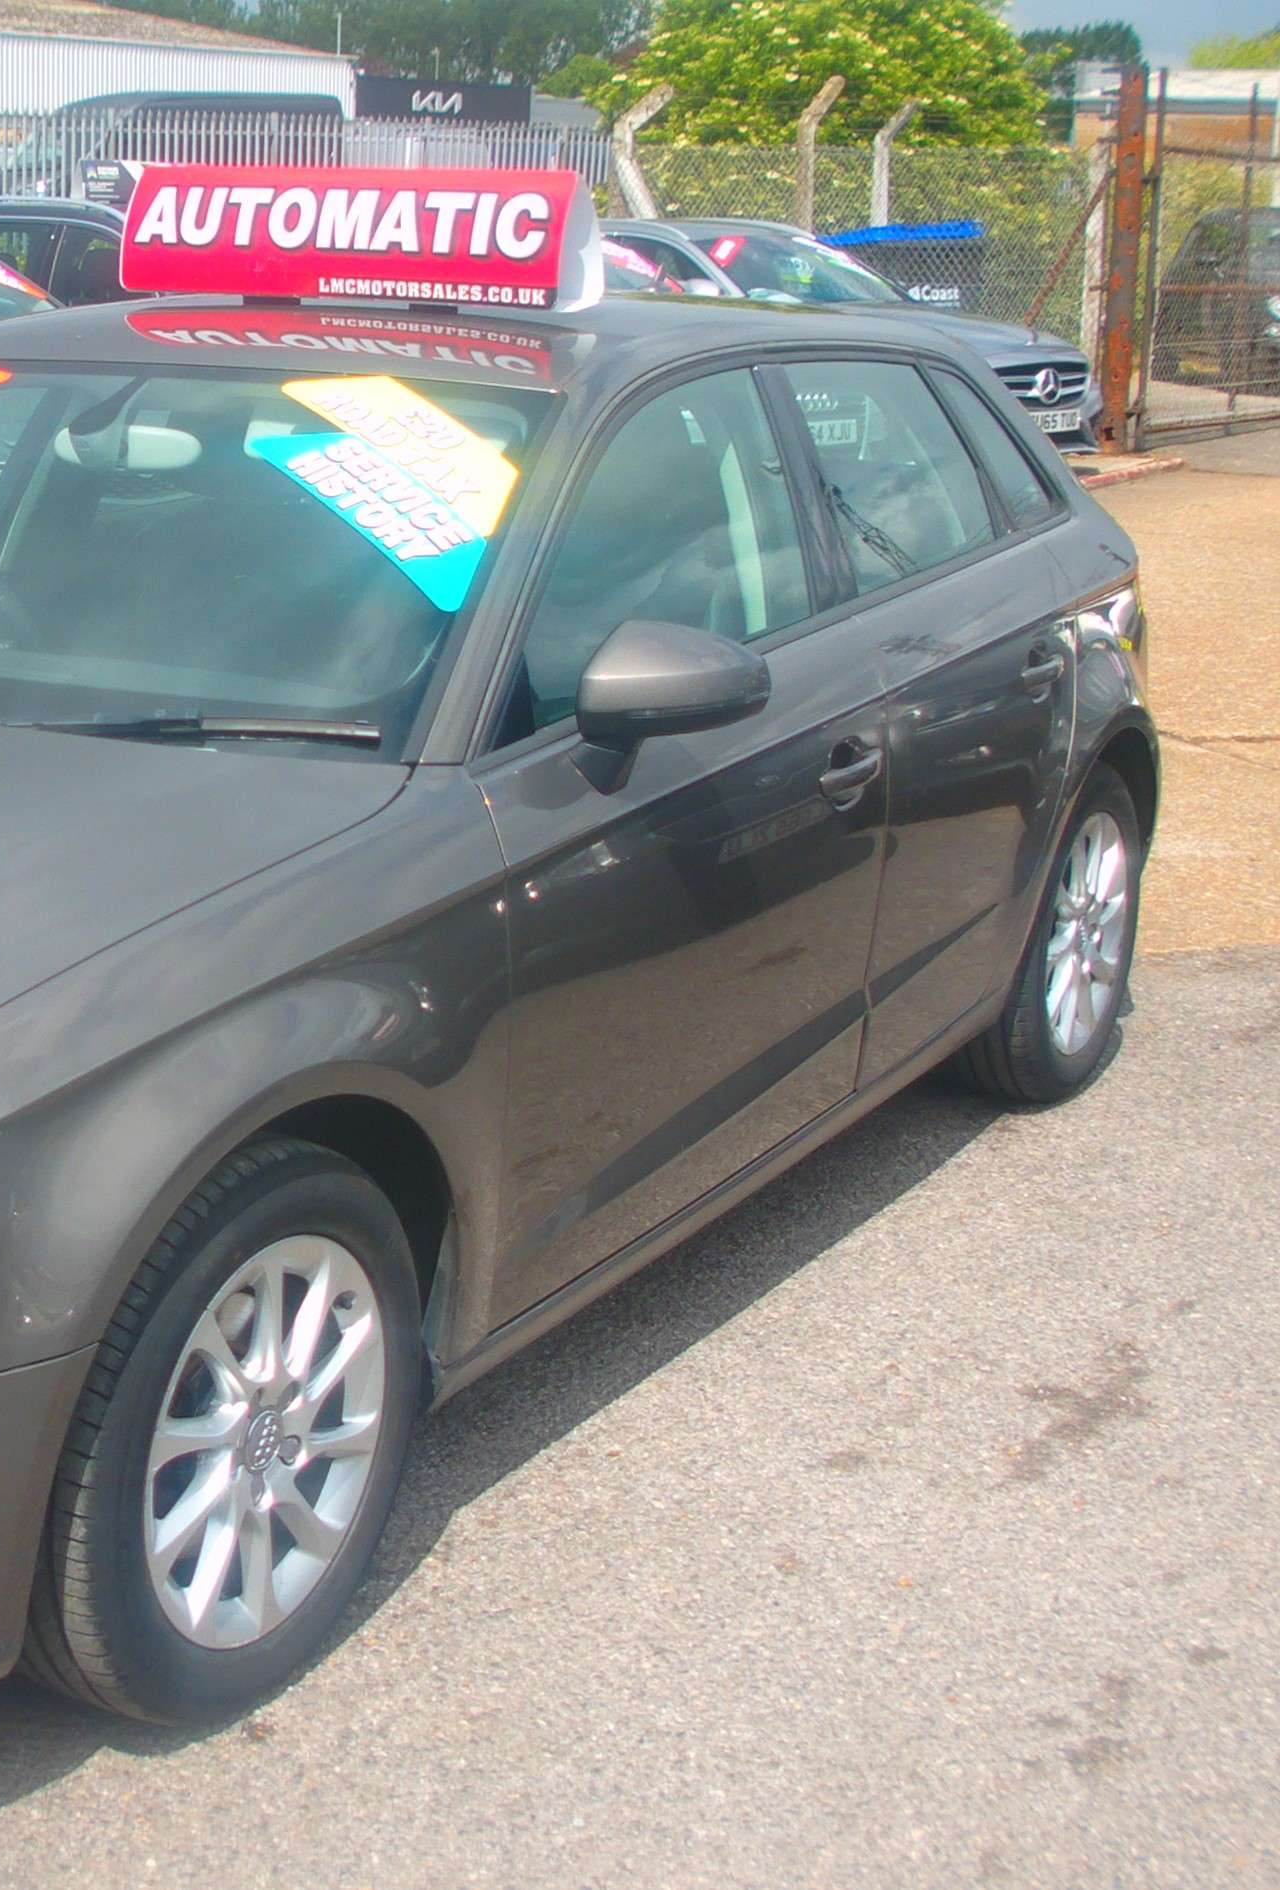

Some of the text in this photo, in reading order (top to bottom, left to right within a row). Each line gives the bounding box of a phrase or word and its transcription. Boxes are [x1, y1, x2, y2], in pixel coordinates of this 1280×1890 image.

[134, 186, 551, 259] AUTOMATIC
[319, 277, 545, 306] LMCMOTORSALES.CO.UK
[285, 450, 442, 562] HISTORY
[324, 437, 474, 553] SERVICE
